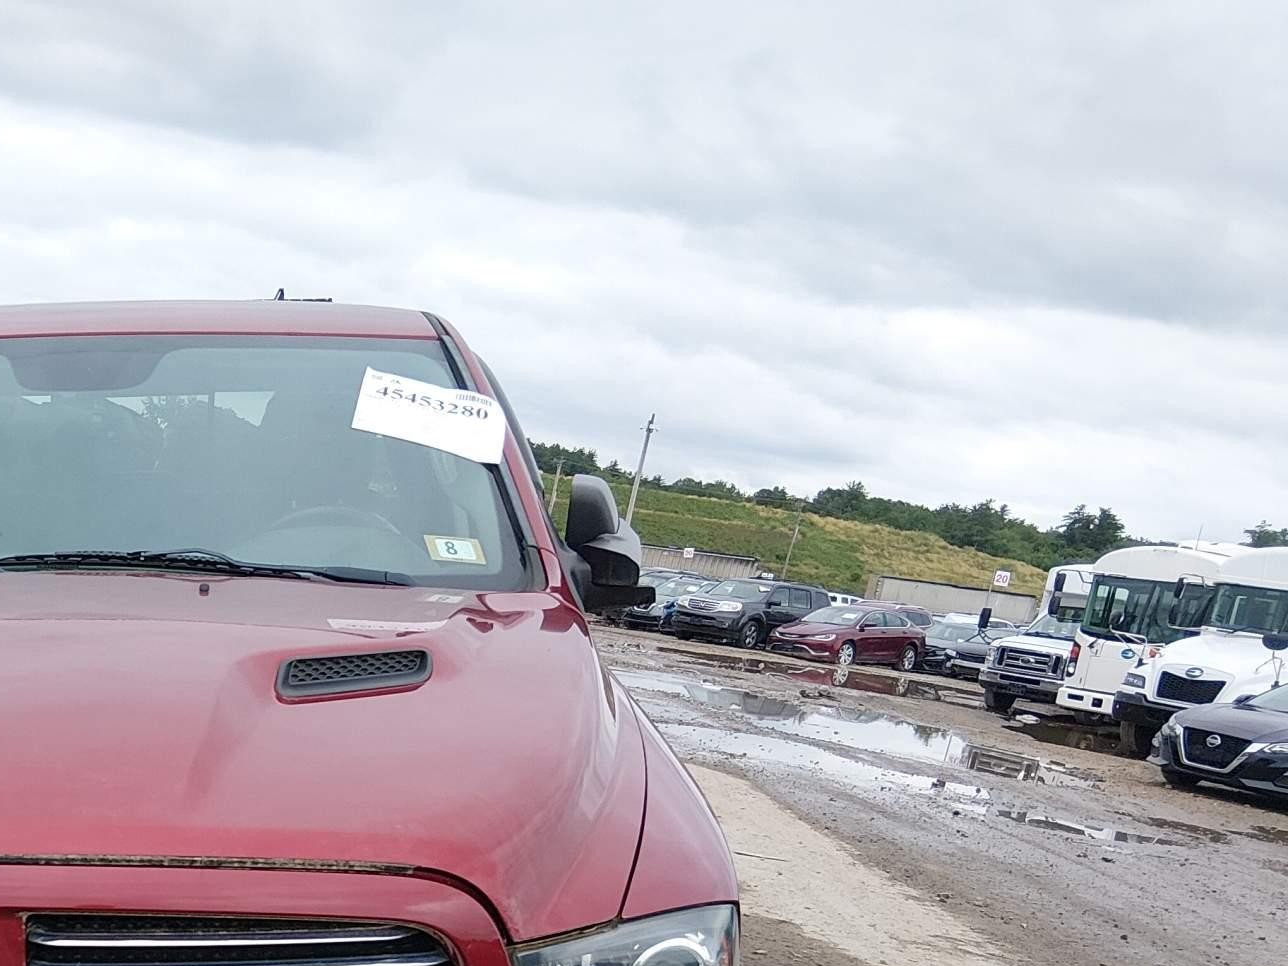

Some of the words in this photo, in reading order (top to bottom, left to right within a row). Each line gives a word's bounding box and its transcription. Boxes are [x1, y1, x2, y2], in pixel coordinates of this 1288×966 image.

[376, 386, 488, 420] 45453280
[444, 541, 458, 555] 8
[996, 574, 1008, 584] 20
